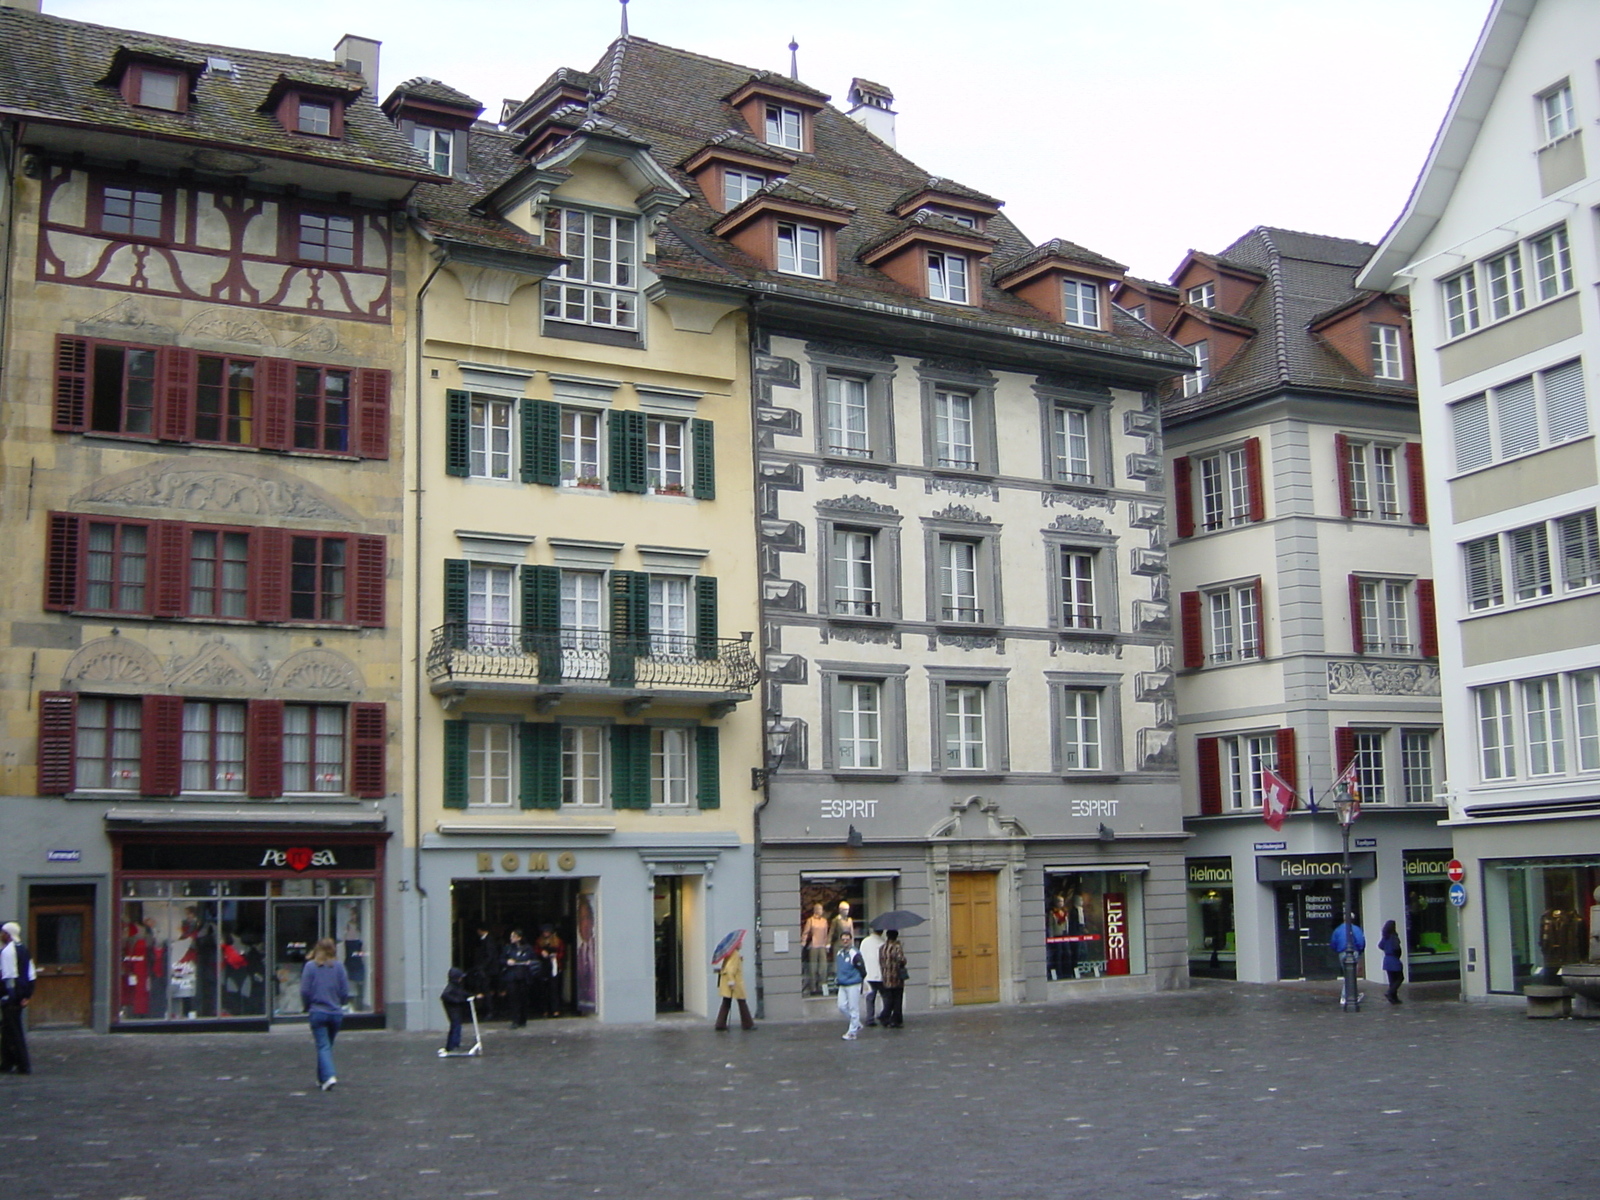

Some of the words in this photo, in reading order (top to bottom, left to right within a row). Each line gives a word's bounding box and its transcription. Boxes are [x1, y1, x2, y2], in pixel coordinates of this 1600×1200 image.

[821, 799, 879, 818] ESPRIT
[1071, 799, 1119, 816] ESPRIT
[477, 851, 576, 872] ROMO
[1107, 899, 1124, 960] ESPRIT
